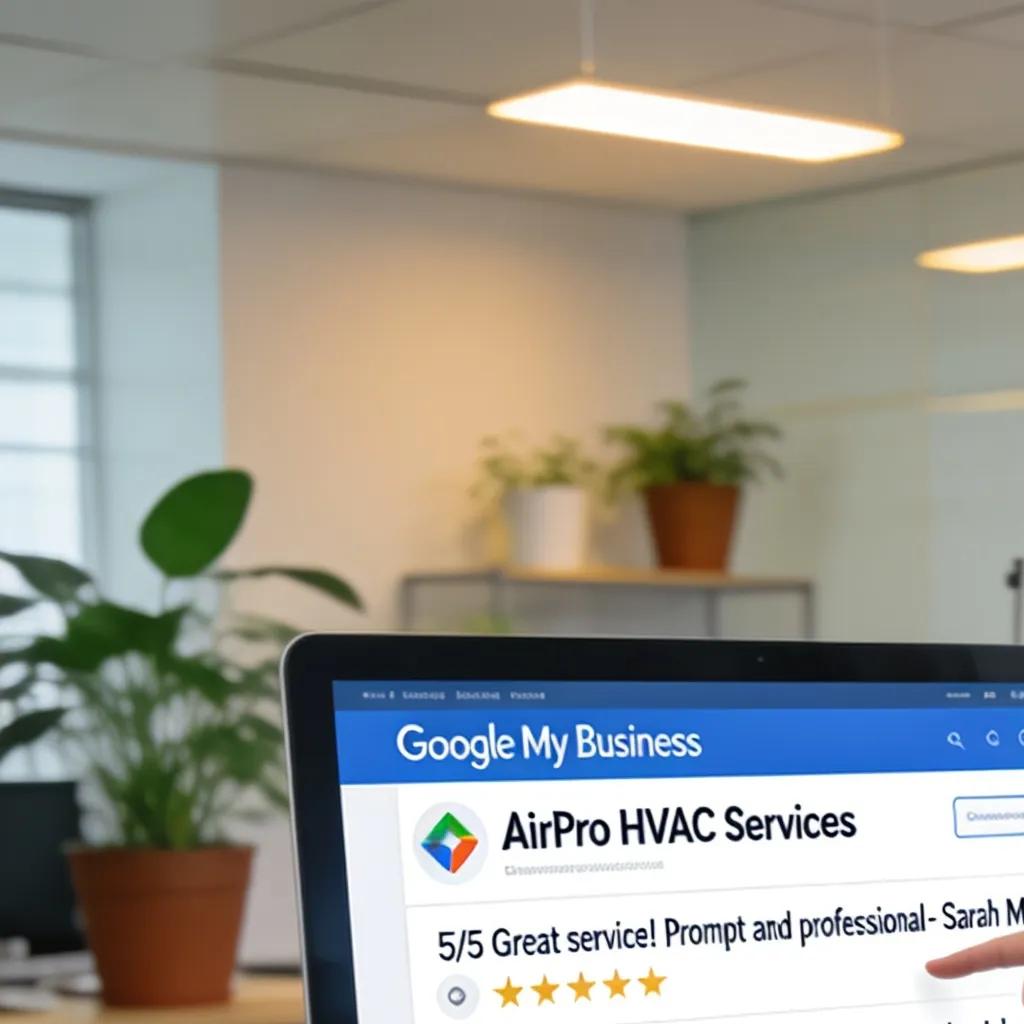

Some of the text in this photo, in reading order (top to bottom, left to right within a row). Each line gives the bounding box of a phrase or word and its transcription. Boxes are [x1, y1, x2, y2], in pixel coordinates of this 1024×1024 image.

[396, 723, 702, 770] Google My Business
[502, 803, 857, 850] AirPro HVAC Services
[438, 929, 484, 963] 5/5
[492, 926, 561, 957] Great
[567, 918, 657, 951] service!
[664, 917, 747, 952] Prompt
[753, 910, 792, 941] and
[943, 899, 999, 929] Sarah
